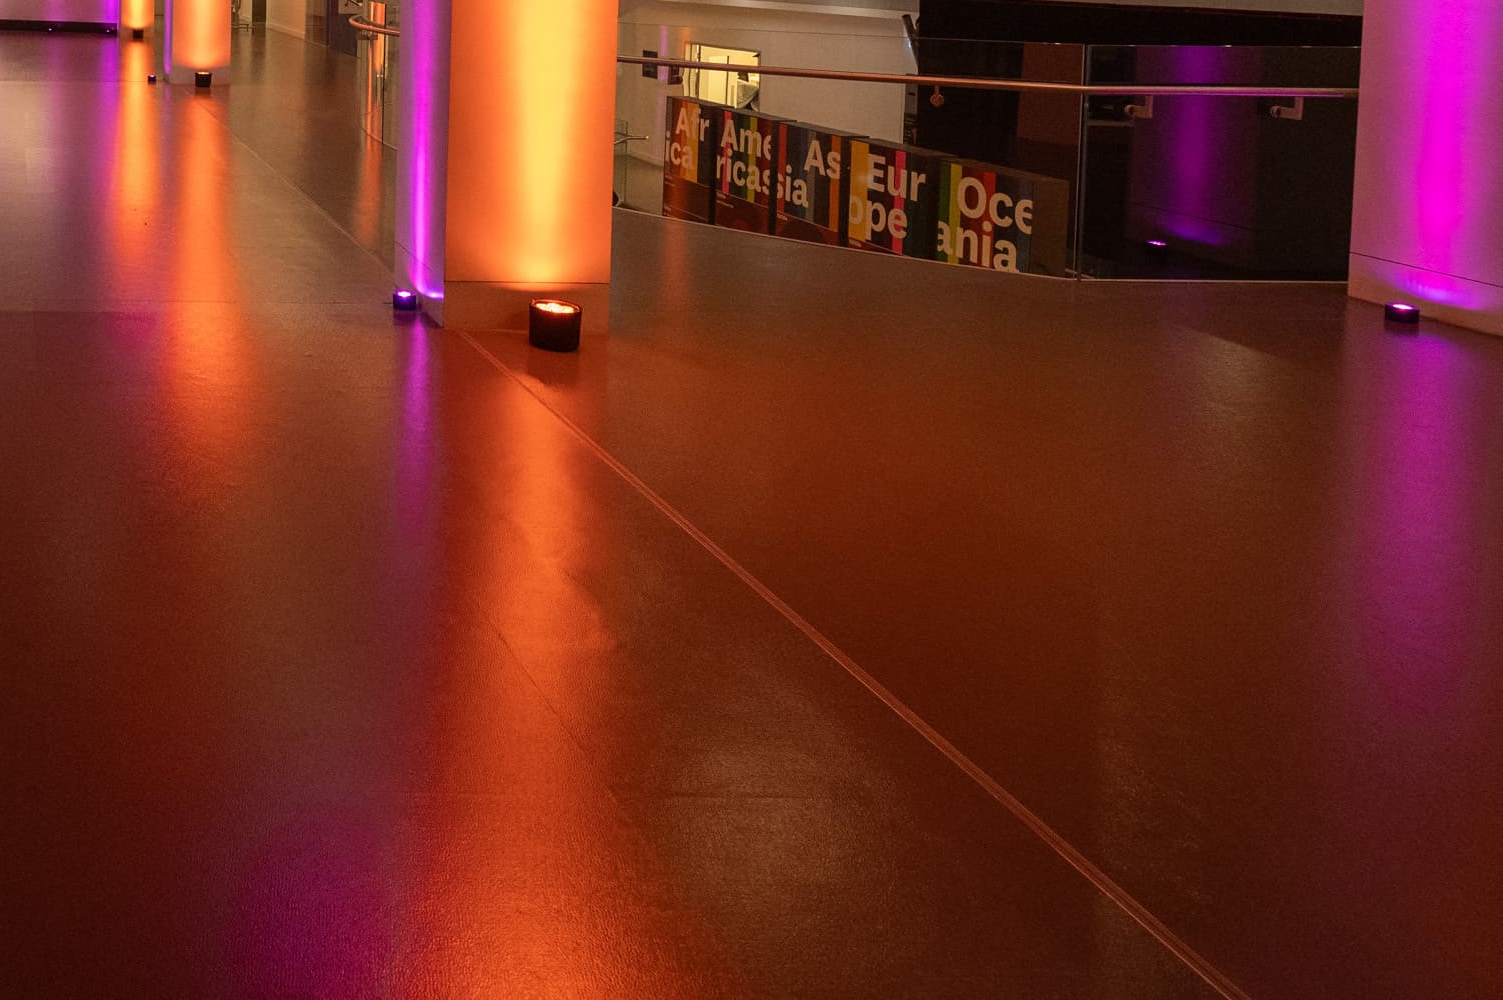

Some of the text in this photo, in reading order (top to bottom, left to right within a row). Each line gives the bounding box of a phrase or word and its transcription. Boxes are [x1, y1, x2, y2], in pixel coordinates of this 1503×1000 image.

[675, 107, 710, 142] Afr
[720, 119, 772, 160] Ame
[804, 140, 841, 179] As
[867, 153, 926, 202] Eur
[958, 176, 1034, 235] Oce
